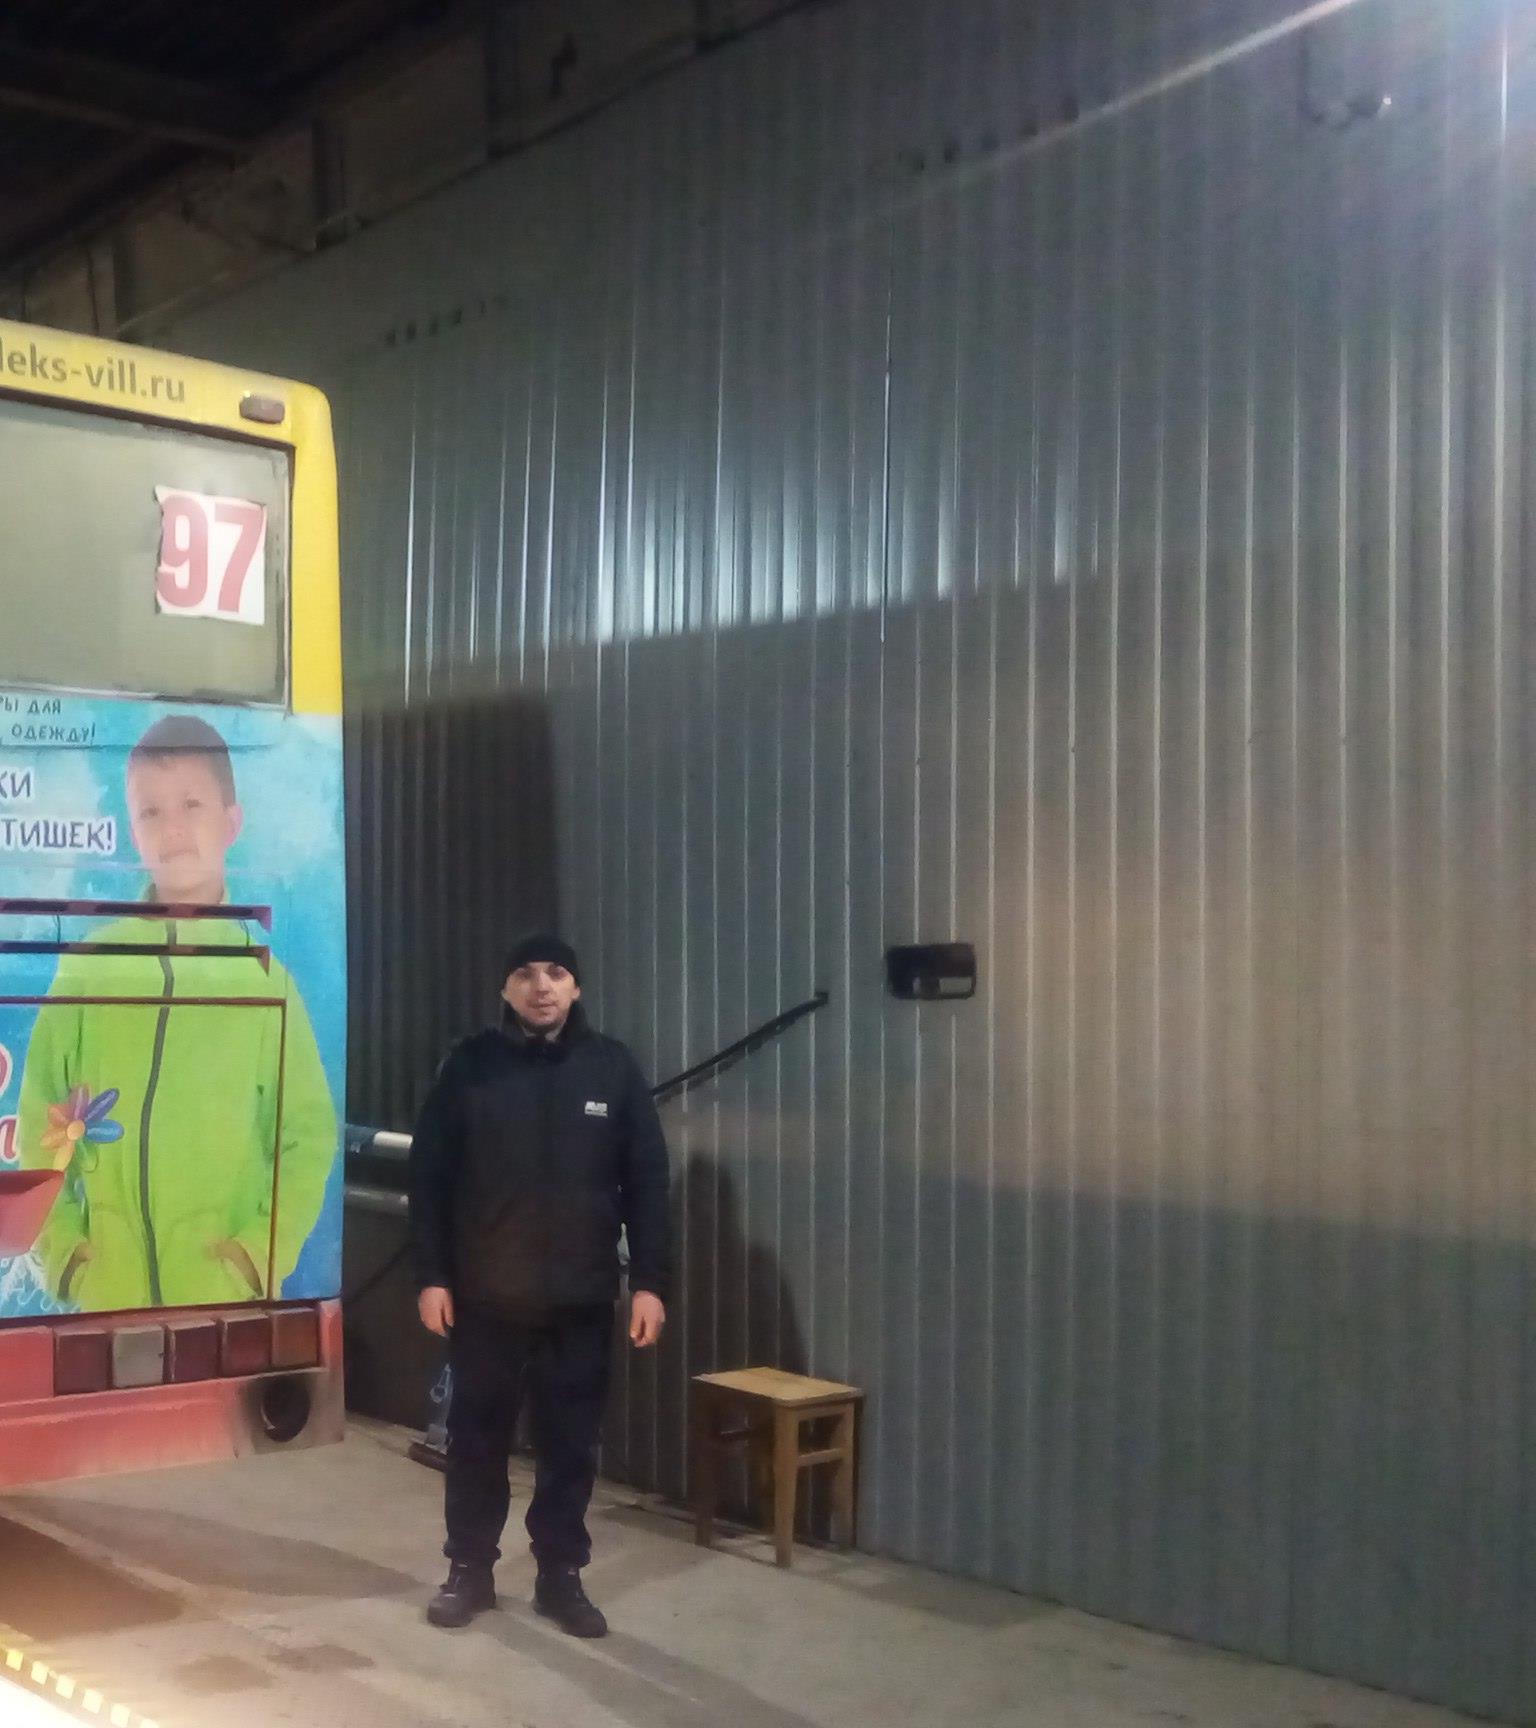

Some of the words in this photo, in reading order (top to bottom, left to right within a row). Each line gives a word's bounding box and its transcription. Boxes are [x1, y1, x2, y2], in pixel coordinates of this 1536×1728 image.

[157, 495, 263, 613] 97
[27, 700, 62, 714] ДЛЯ
[11, 721, 97, 744] ОДЕЖДУ!
